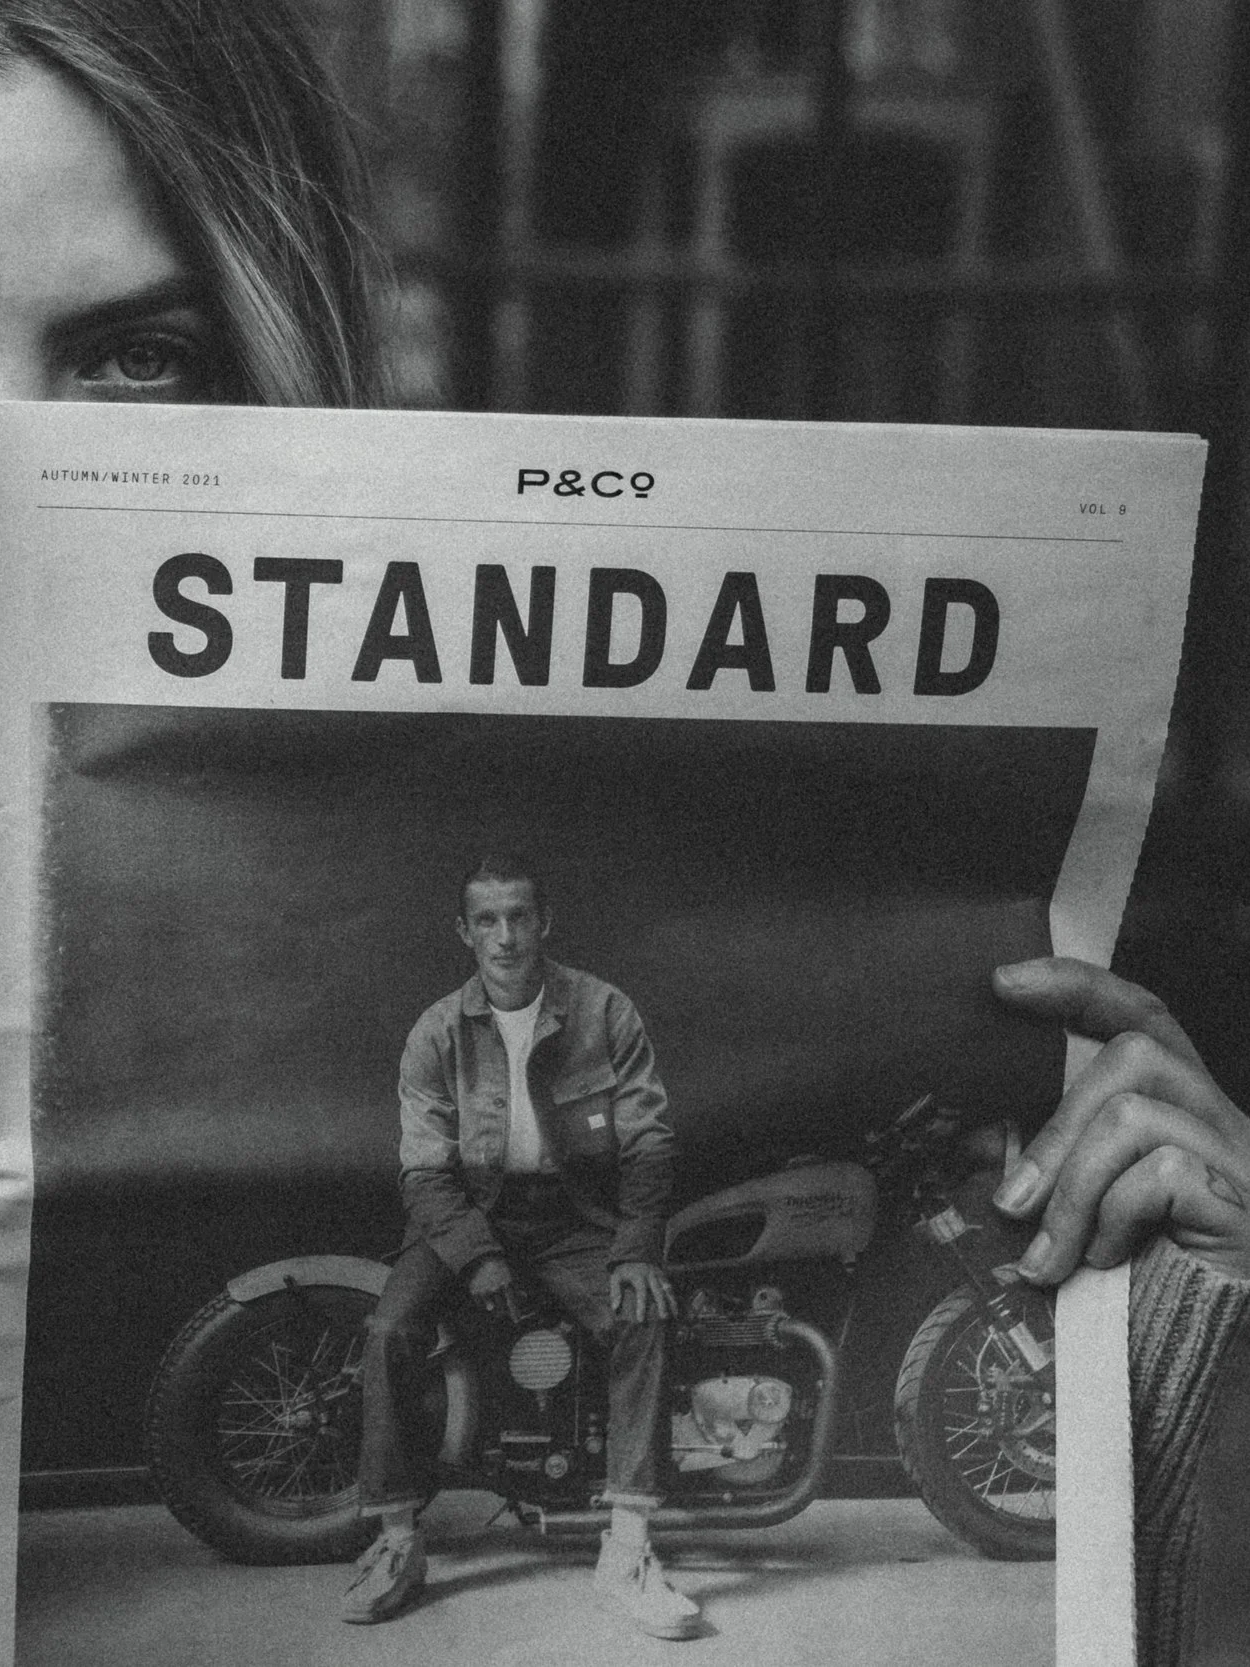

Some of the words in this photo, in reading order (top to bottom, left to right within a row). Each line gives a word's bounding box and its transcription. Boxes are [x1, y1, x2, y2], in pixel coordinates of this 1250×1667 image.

[40, 469, 170, 485] AUTUMN/WINTER
[182, 474, 220, 486] 2021
[1079, 503, 1107, 515] VOL
[147, 553, 1000, 697] STANDARD
